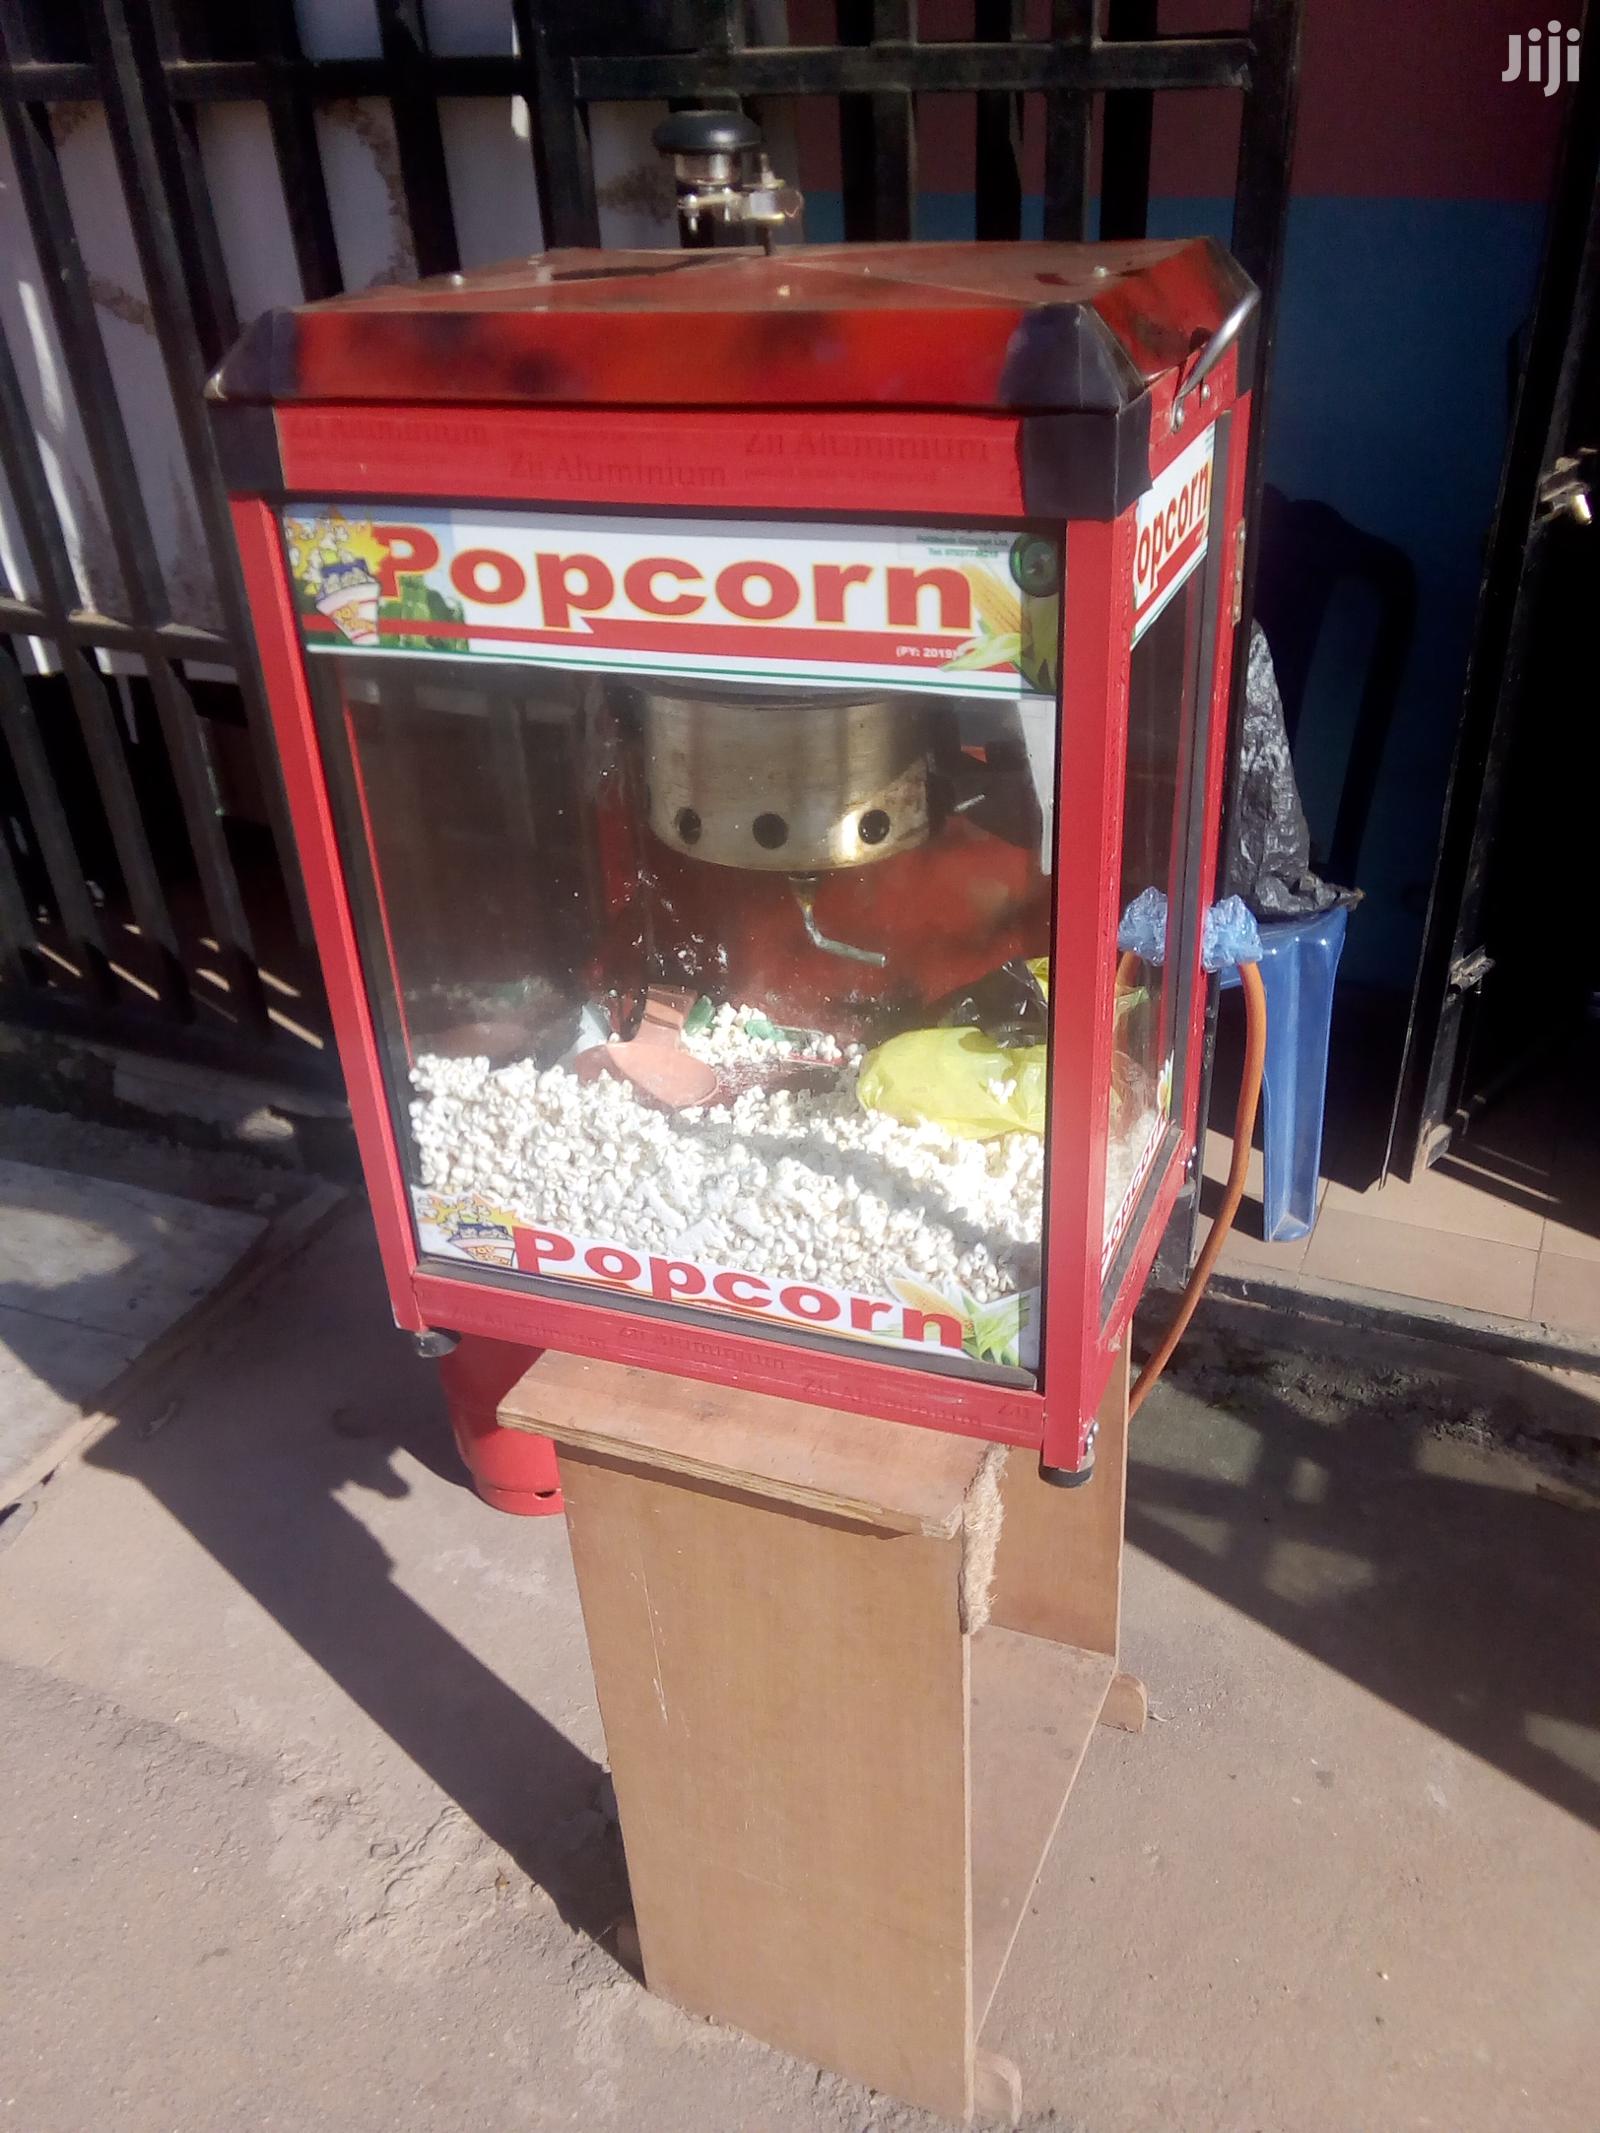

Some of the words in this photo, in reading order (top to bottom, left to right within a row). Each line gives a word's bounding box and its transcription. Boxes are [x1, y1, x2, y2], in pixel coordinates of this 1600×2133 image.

[552, 452, 727, 488] Aluminium
[1136, 459, 1210, 592] opcorn
[371, 523, 974, 633] Popcorn
[513, 1226, 964, 1351] Popcorn
